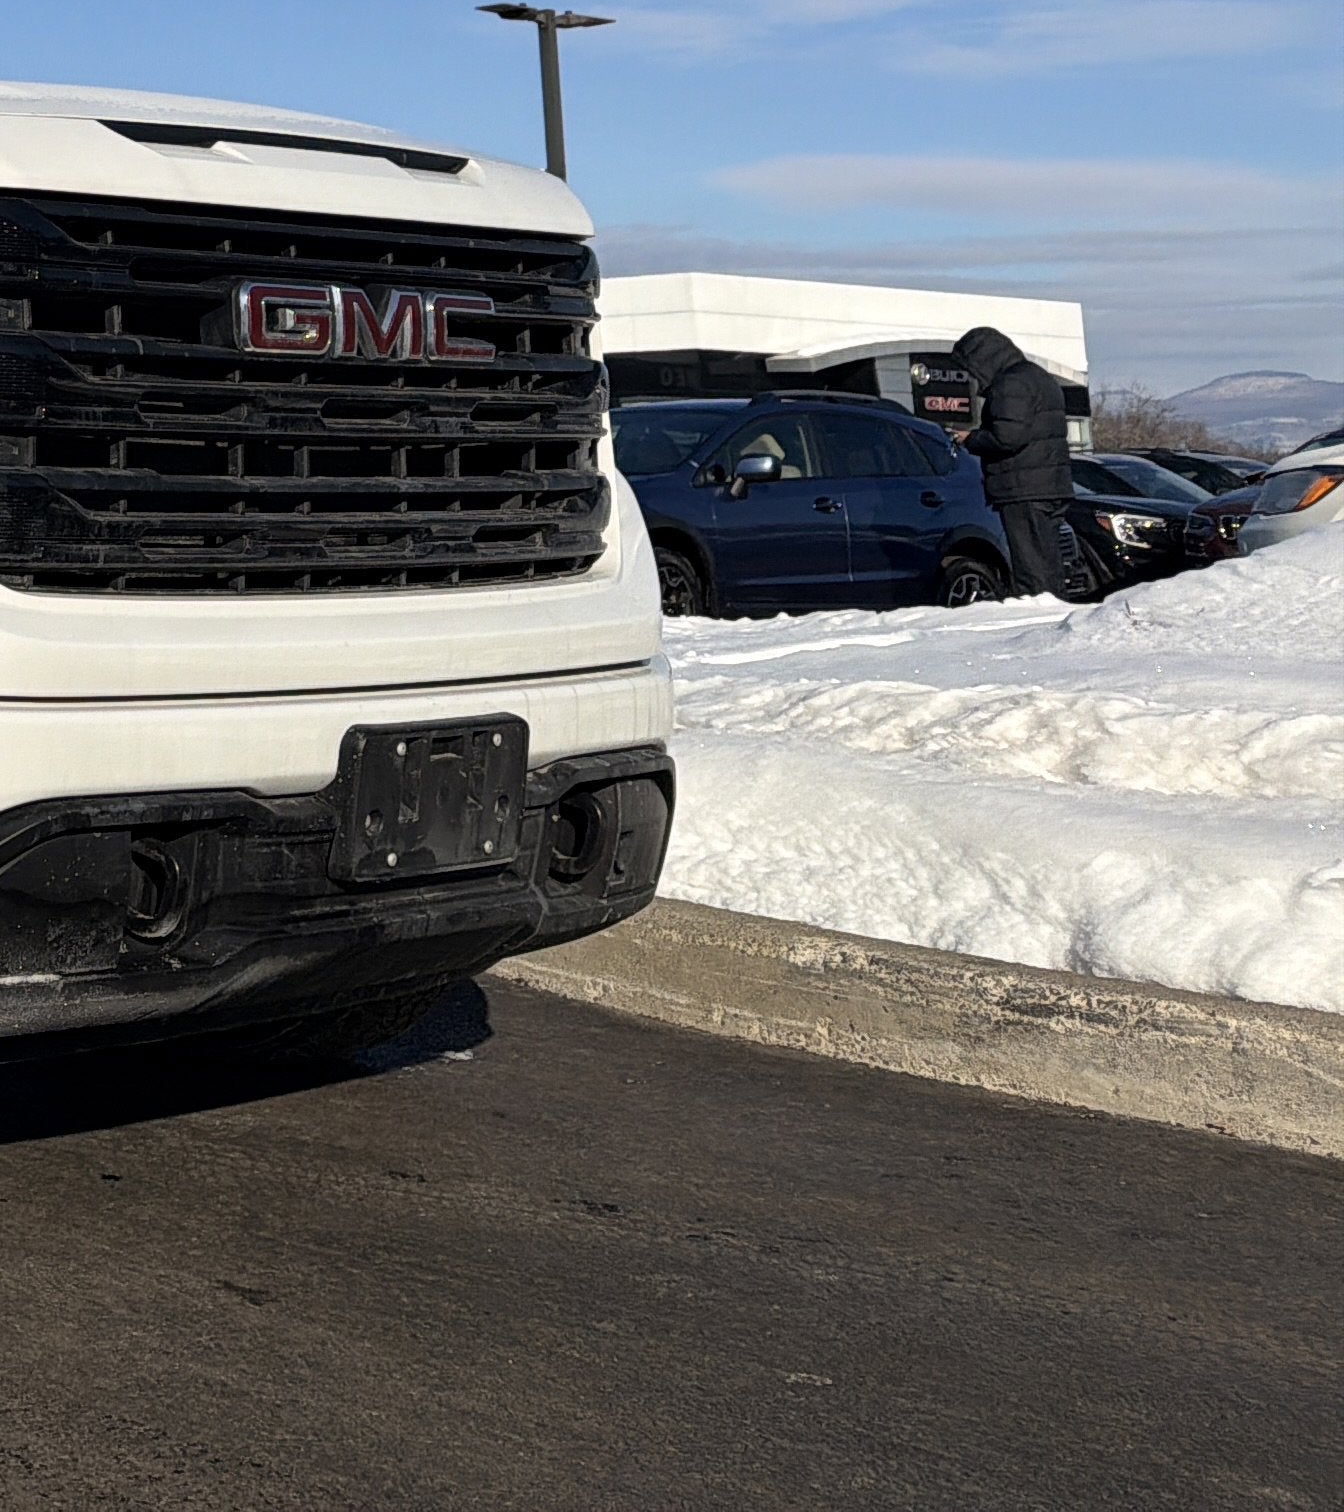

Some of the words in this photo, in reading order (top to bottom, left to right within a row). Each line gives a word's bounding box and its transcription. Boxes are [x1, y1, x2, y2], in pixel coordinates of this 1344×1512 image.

[239, 281, 496, 362] GMC
[930, 369, 970, 382] BUIC
[924, 396, 970, 413] GMC
